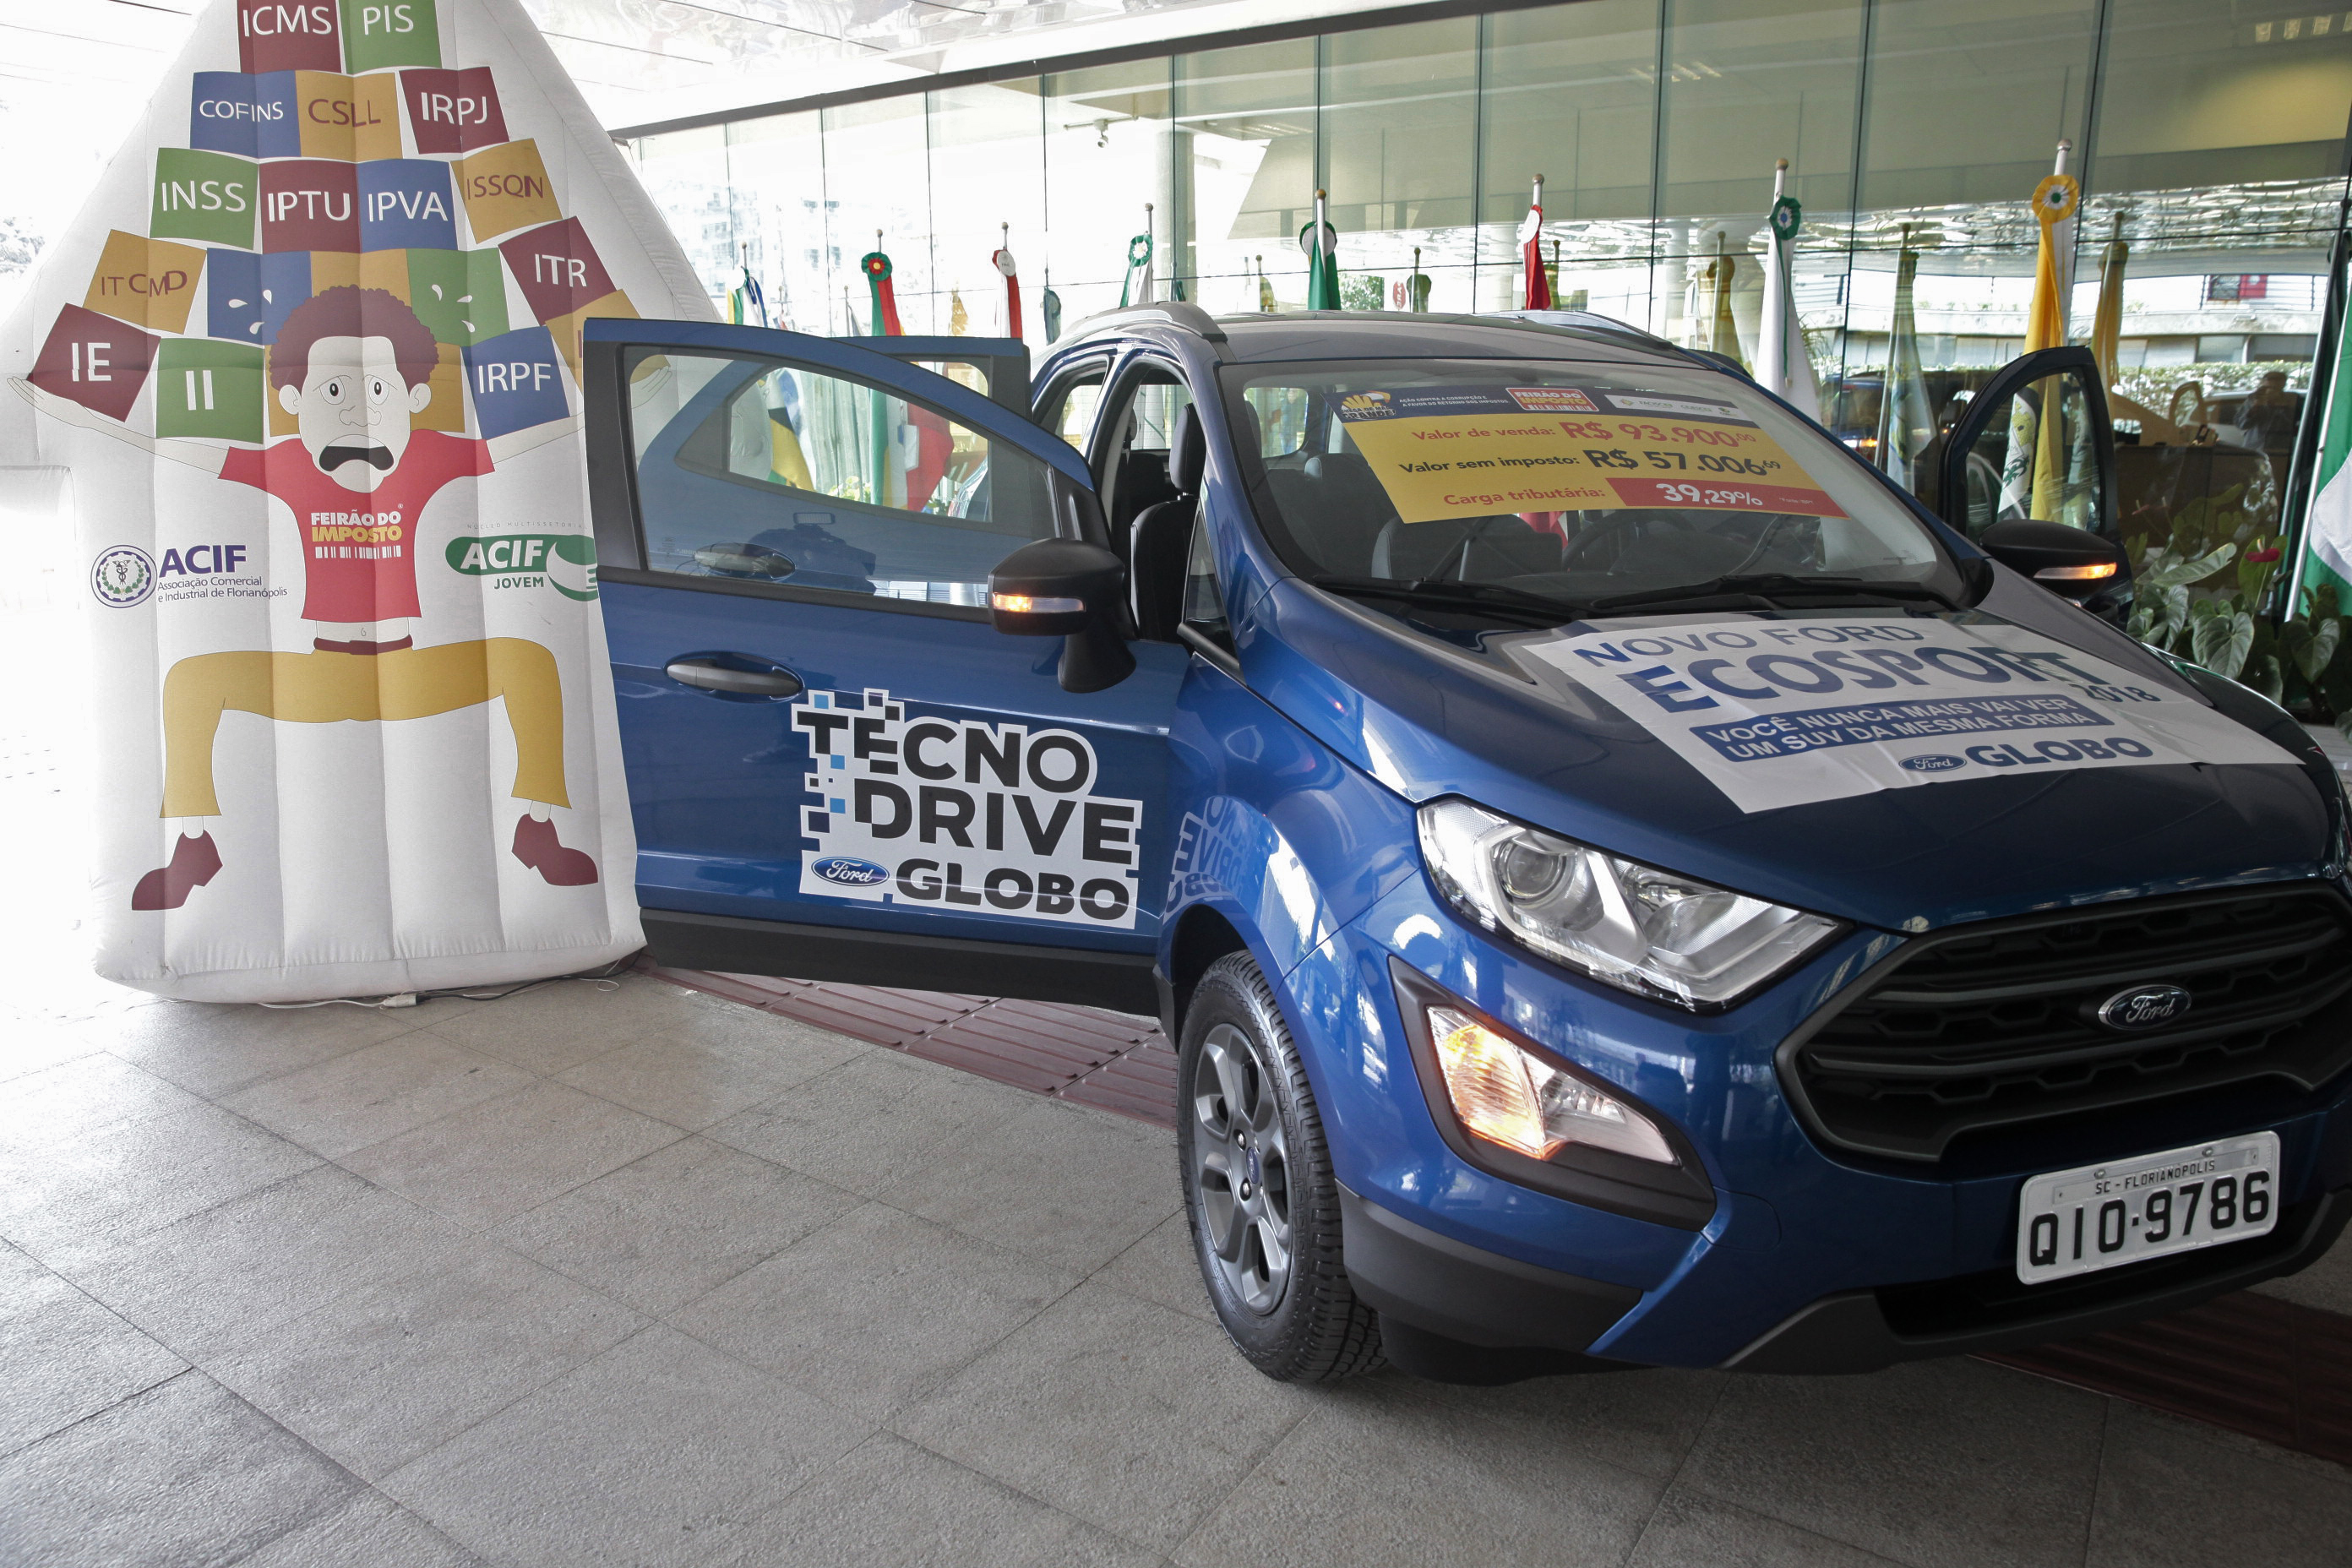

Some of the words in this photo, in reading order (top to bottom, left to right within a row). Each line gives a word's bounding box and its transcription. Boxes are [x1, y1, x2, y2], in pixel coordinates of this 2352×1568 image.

[242, 5, 333, 36] ICMS
[362, 6, 414, 35] PIS
[199, 100, 285, 122] COFINS
[308, 98, 382, 128] CSLL
[421, 92, 487, 126] IRPJ
[161, 181, 247, 213] INSS
[466, 174, 544, 200] ISSQN
[267, 191, 351, 222] IPTU
[368, 191, 448, 222] IPVA
[534, 253, 587, 288] ITR
[71, 342, 112, 383] IE
[186, 370, 214, 410] II
[477, 362, 552, 395] IRPF
[1412, 429, 1461, 440] Valor
[1467, 428, 1491, 437] de
[1494, 427, 1556, 436] venda:
[1560, 422, 1614, 440] R$
[1399, 462, 1450, 473] Valor
[1458, 460, 1495, 469] sem
[1498, 456, 1580, 468] imposto:
[1582, 448, 1638, 470] R$
[1443, 494, 1505, 505] Carga
[1508, 487, 1605, 501] tributária:
[1656, 483, 1764, 506] 39,29%
[311, 509, 374, 526] FEIRÃO
[377, 511, 401, 525] DO
[312, 525, 402, 543] IMPOSTO
[158, 545, 247, 578] ACIF
[460, 539, 543, 570] ACIF
[157, 578, 208, 591] Associação
[210, 576, 262, 587] Comercial
[166, 589, 209, 602] Industrial
[211, 588, 225, 598] de
[226, 586, 287, 600] Florianópolis
[493, 576, 544, 590] JOVEM
[1573, 631, 1757, 667] NOVO
[1759, 625, 1925, 645] FORD
[1615, 646, 2112, 713] ECOSPORT
[2069, 683, 2162, 703] 2018
[1706, 716, 1799, 742] VOCÊ
[1799, 708, 1903, 727] NUNCA
[1903, 702, 1974, 718] MAIS
[1969, 700, 2020, 713] VAI
[2019, 698, 2078, 710] VER
[1727, 741, 1782, 758] UM
[1780, 728, 1844, 750] SUV
[1844, 724, 1892, 741] DA
[1892, 716, 1997, 735] MESMA
[1996, 711, 2097, 728] FORMA
[797, 710, 1090, 793] TECNO
[1911, 754, 1957, 770] Ford
[1964, 737, 2153, 767] GLOBO
[854, 778, 1135, 865] DRIVE
[823, 858, 877, 885] Ford
[896, 858, 1130, 921] GLOBO
[2124, 993, 2177, 1024] Ford
[2095, 1181, 2110, 1195] SC
[2125, 1160, 2215, 1189] FLORIANOPOLIS
